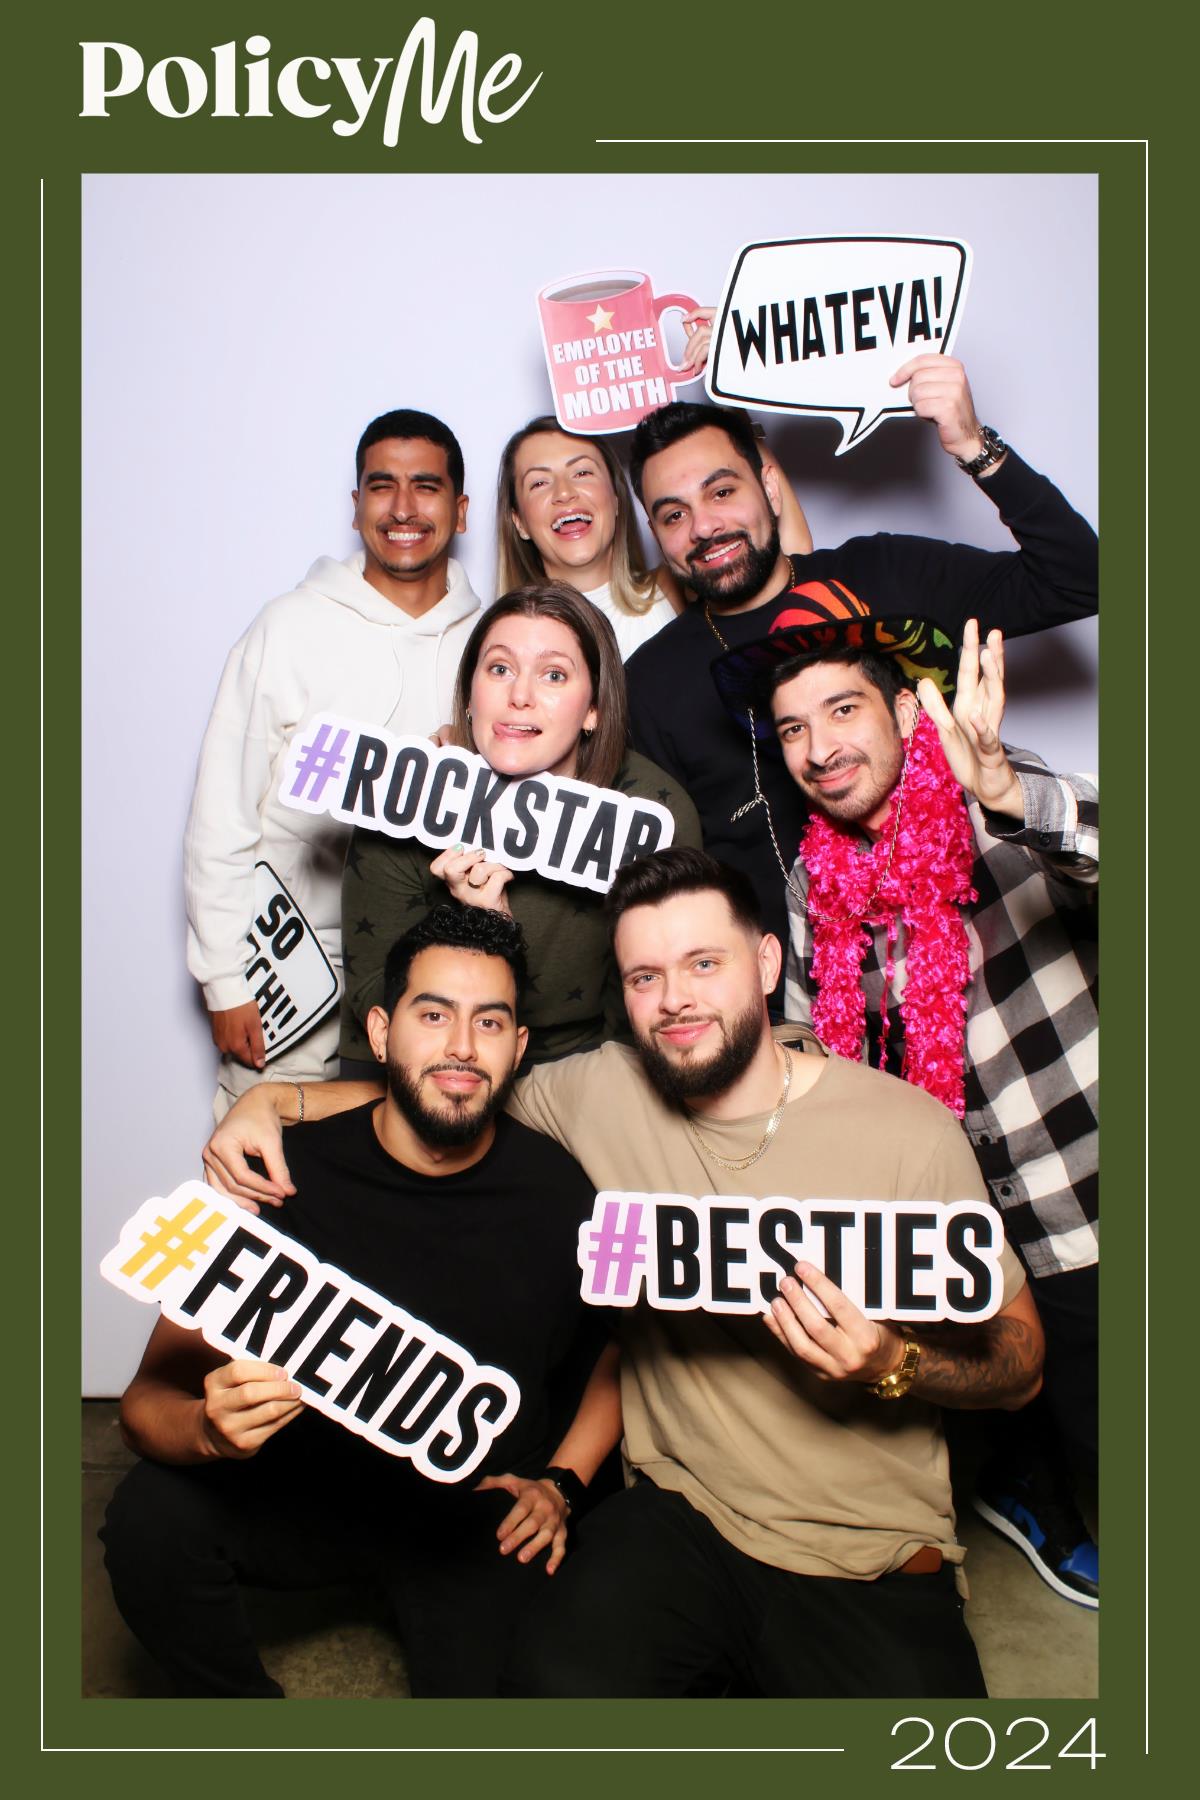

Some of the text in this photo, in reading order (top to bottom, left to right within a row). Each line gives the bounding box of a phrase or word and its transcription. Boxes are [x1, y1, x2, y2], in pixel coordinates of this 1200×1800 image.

[552, 327, 657, 364] EMPLOYEE
[731, 276, 943, 372] WHATEVA!
[563, 377, 668, 420] MONTH
[574, 355, 645, 386] OF THE
[289, 724, 662, 881] #ROCKSTAR
[255, 893, 304, 960] SO
[588, 1202, 993, 1313] #BESTIES
[119, 1197, 508, 1472] #FRIENDS
